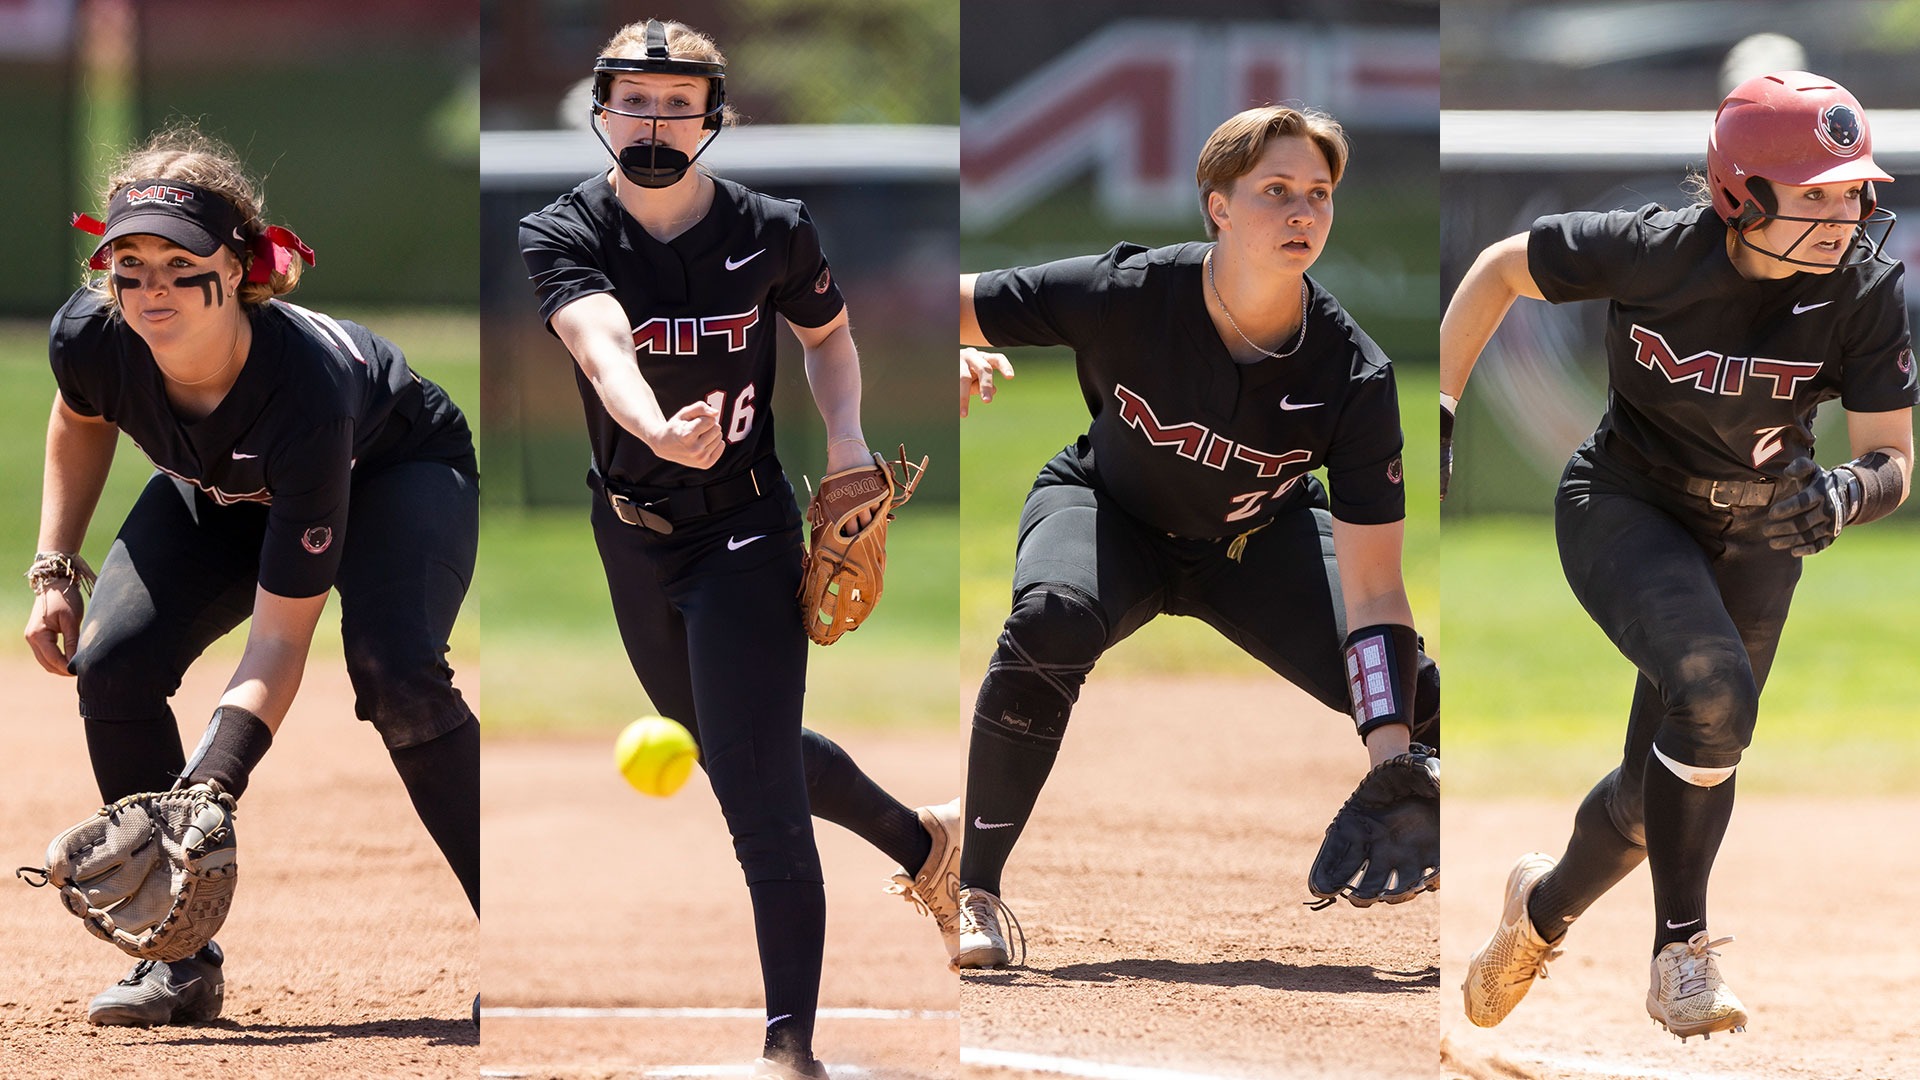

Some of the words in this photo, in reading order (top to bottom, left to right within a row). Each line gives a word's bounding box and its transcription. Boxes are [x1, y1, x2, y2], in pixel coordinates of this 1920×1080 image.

[127, 185, 194, 203] MIT
[1630, 323, 1824, 400] MIT
[1114, 383, 1313, 478] MIT
[826, 477, 880, 503] Wilson
